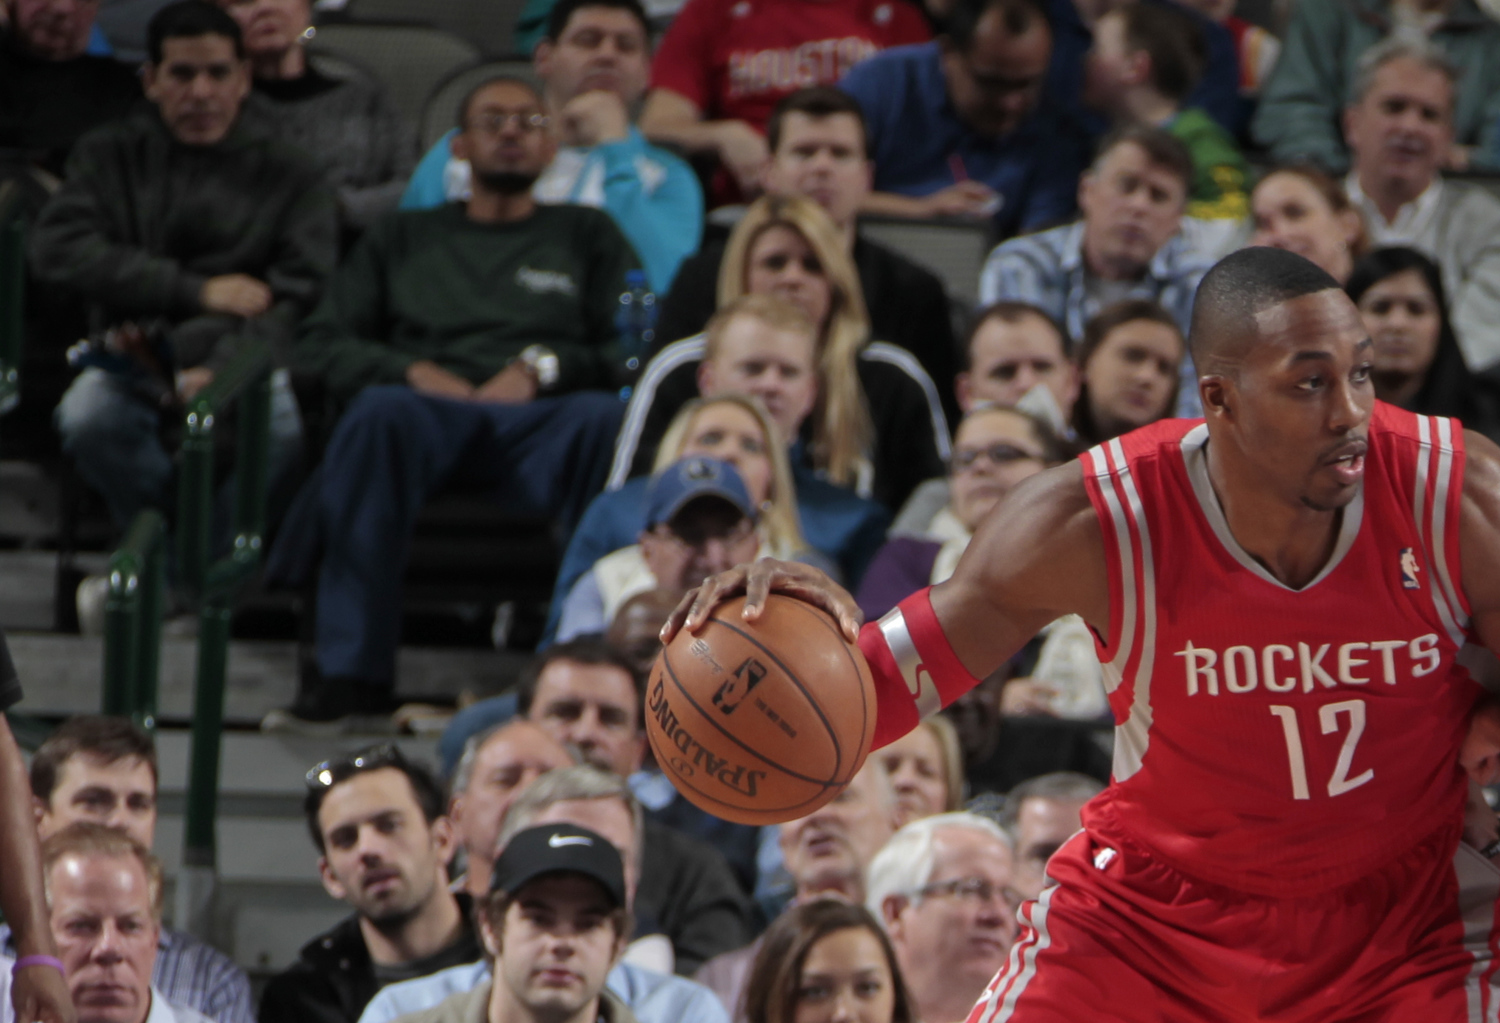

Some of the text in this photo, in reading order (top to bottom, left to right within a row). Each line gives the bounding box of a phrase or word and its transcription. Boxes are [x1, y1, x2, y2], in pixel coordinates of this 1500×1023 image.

[1173, 638, 1441, 697] ROCKETS
[648, 670, 767, 798] SPALDING
[1268, 699, 1375, 800] 12
